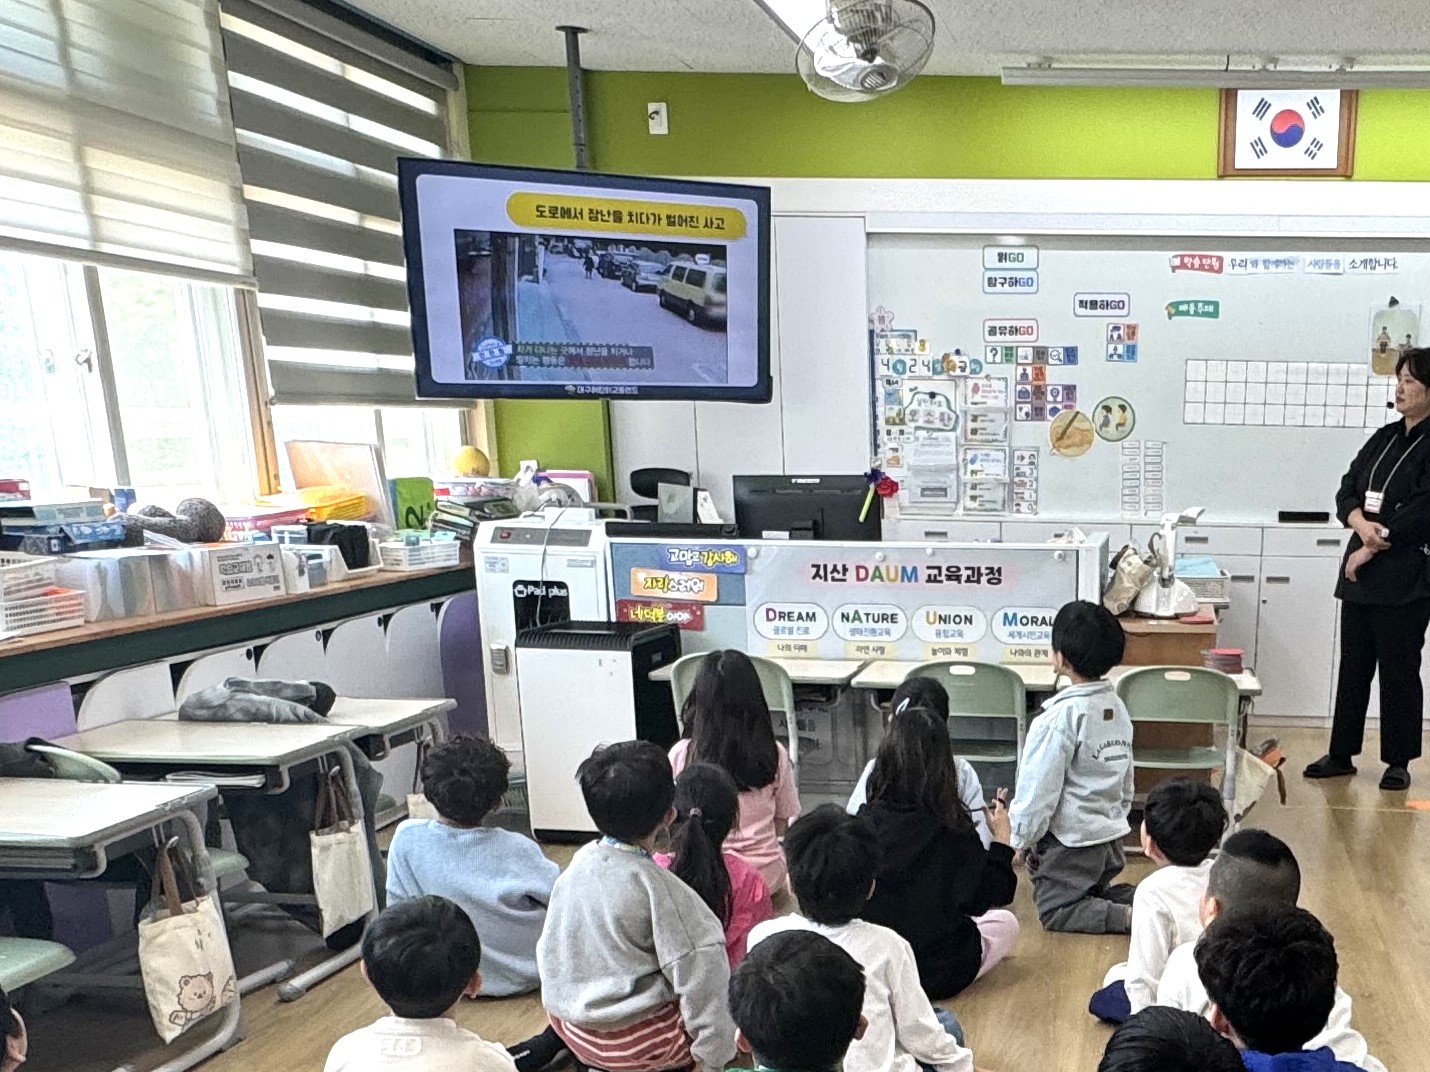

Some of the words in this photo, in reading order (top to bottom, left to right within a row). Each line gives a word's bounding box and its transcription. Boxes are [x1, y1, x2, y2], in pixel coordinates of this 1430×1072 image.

[535, 204, 584, 221] 도로에서
[588, 207, 624, 224] 장난을
[627, 209, 663, 227] 치다가
[703, 216, 726, 231] 사고
[1306, 257, 1342, 271] 사람들을
[986, 276, 1035, 288] 탐구하GO
[810, 563, 849, 583] 지산
[855, 565, 919, 583] DAUM
[925, 565, 1004, 586] 교육과정
[765, 607, 817, 623] DREAM
[840, 609, 899, 624] NATURE
[925, 611, 973, 626] UNION
[1003, 612, 1055, 627] MORAL
